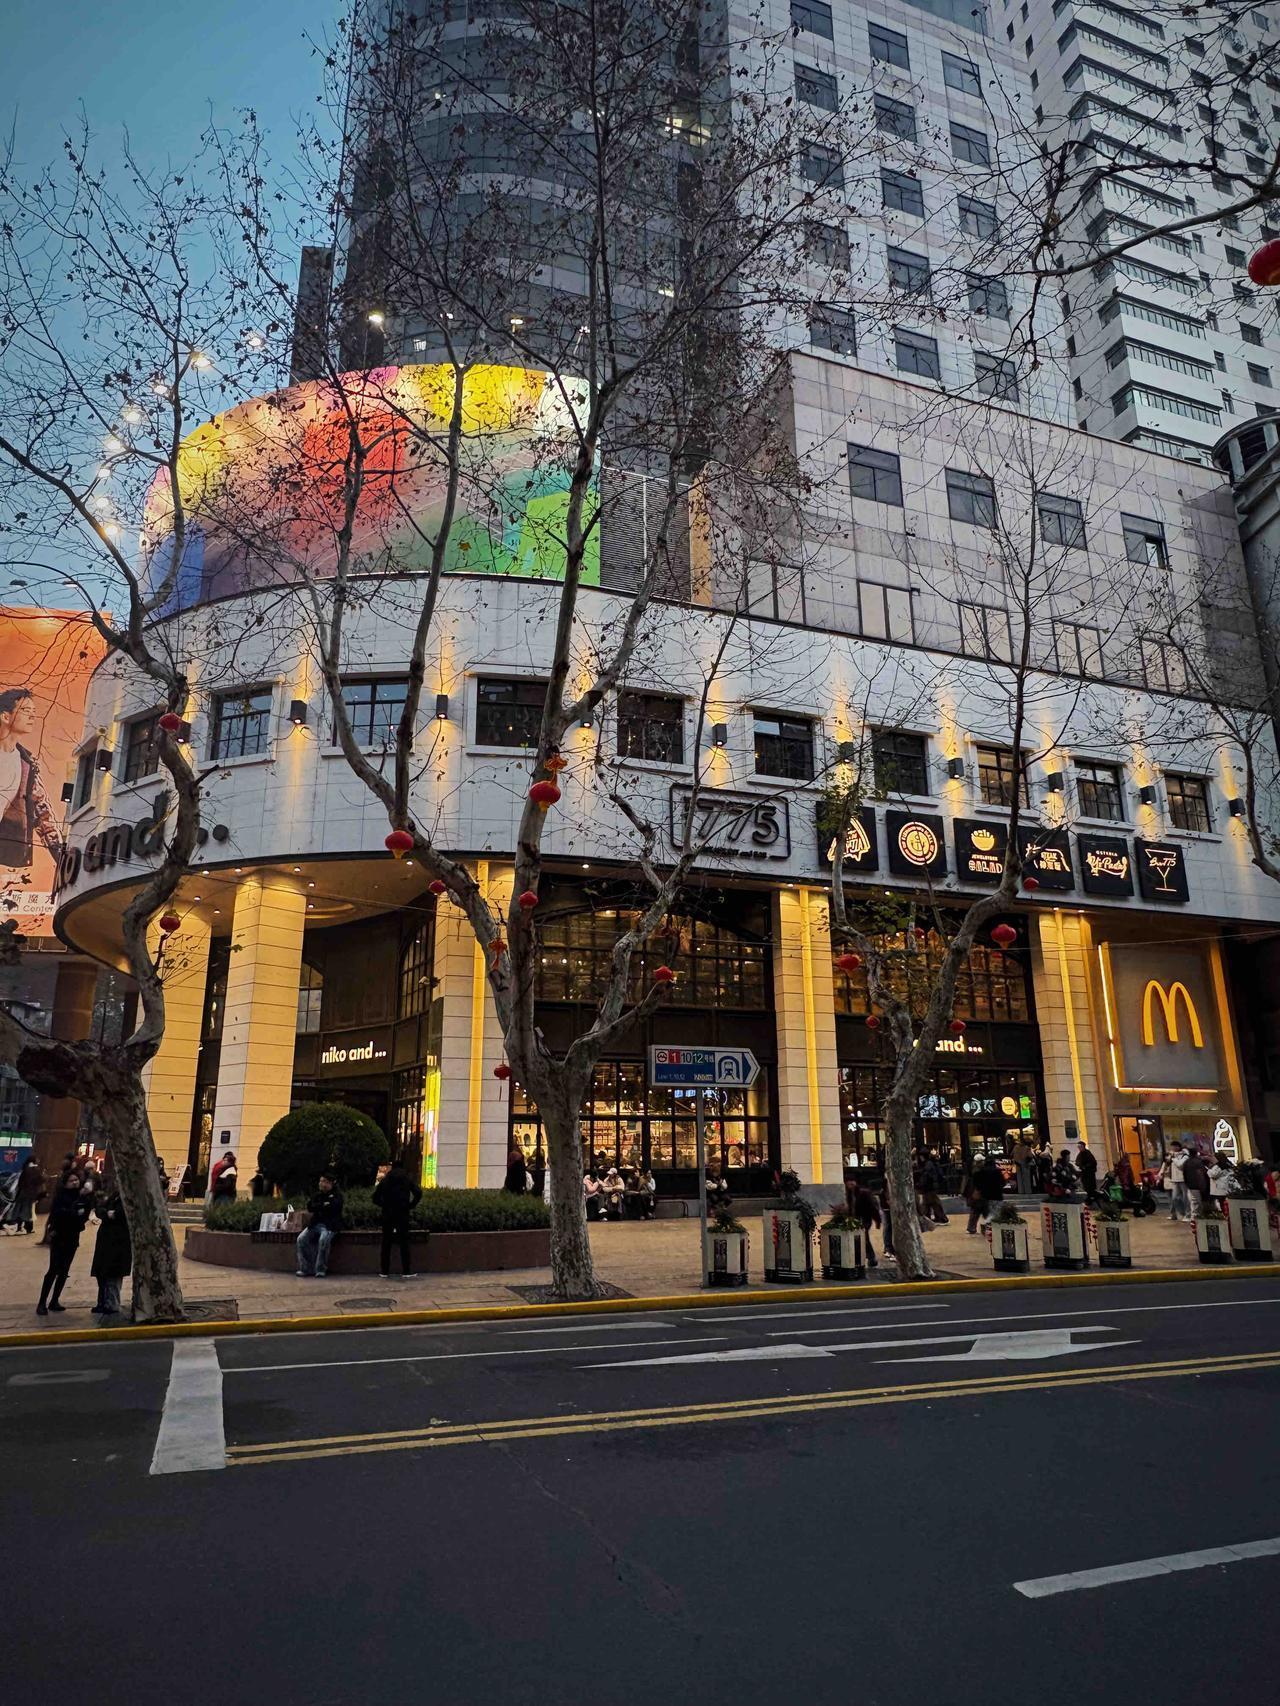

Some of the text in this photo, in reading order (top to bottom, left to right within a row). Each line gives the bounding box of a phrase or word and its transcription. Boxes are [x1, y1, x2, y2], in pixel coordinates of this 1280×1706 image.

[968, 860, 1003, 874] SALAD
[321, 1046, 347, 1064] niko
[348, 1040, 374, 1061] and
[681, 1052, 692, 1063] 10
[692, 1052, 704, 1064] 12
